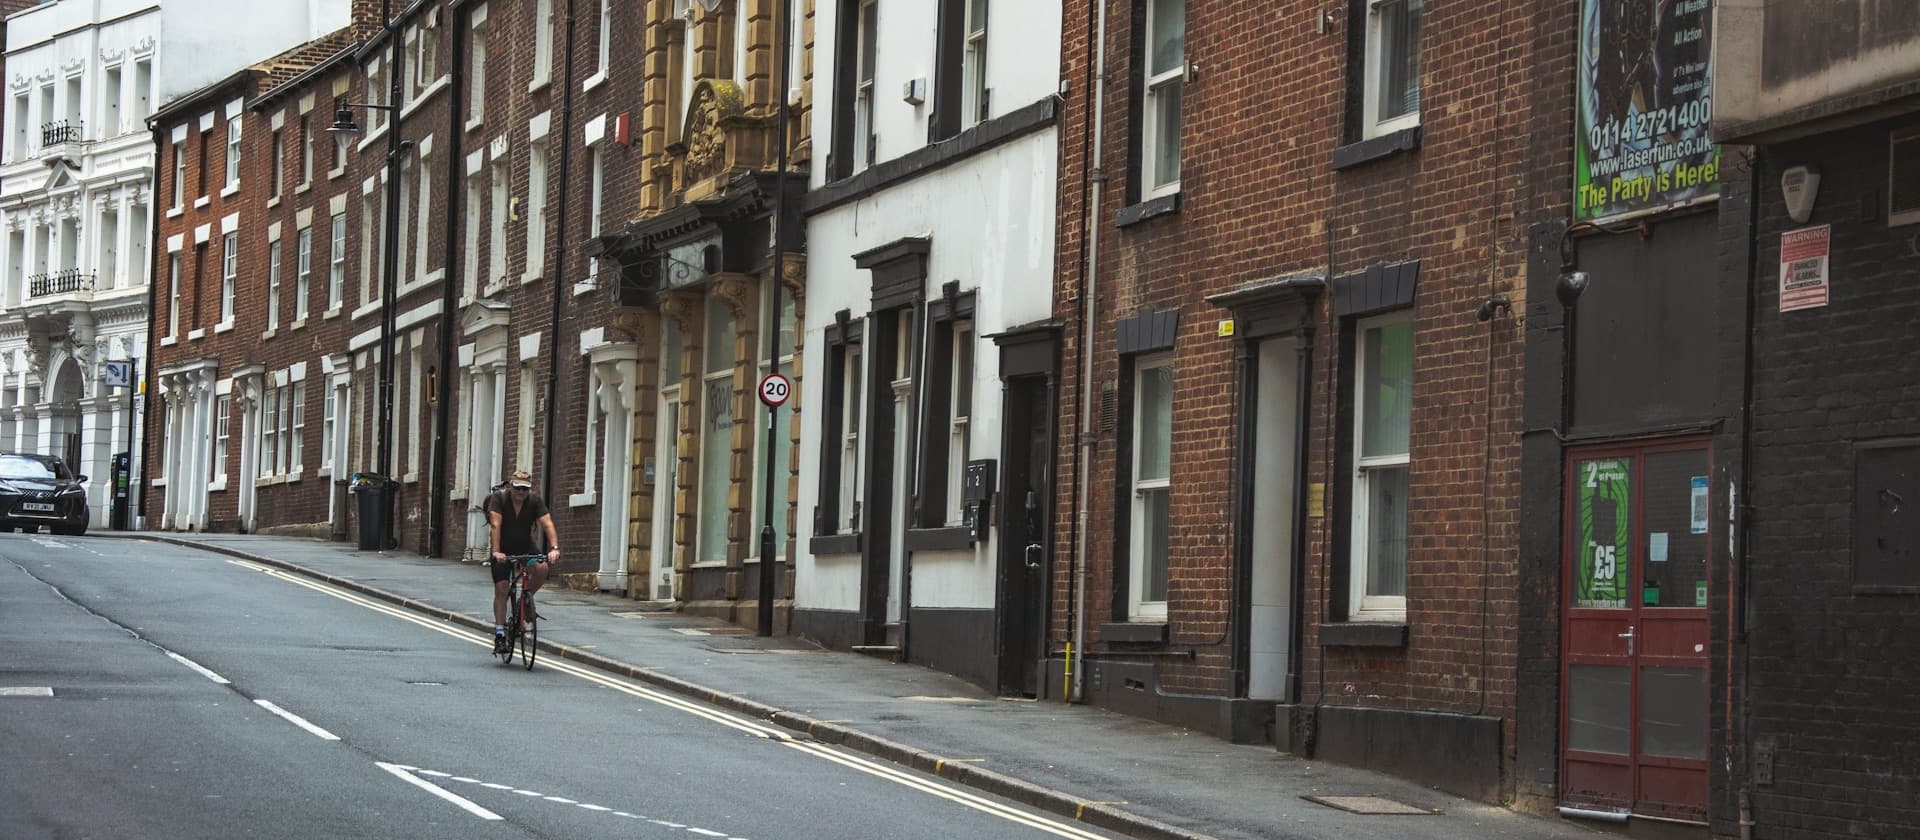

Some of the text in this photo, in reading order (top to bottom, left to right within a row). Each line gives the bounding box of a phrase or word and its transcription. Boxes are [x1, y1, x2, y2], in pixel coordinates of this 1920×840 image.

[1675, 0, 1708, 17] All Weather
[1674, 28, 1702, 46] All Action
[1592, 97, 1711, 150] 0114 2721400
[1590, 135, 1712, 177] www.laserfun.co.uk
[1579, 155, 1721, 210] The Party is Here!
[1784, 228, 1827, 244] WARNING
[765, 382, 787, 396] 20
[975, 475, 979, 486] 2
[1586, 461, 1598, 488] 2
[1594, 545, 1615, 579] £5
